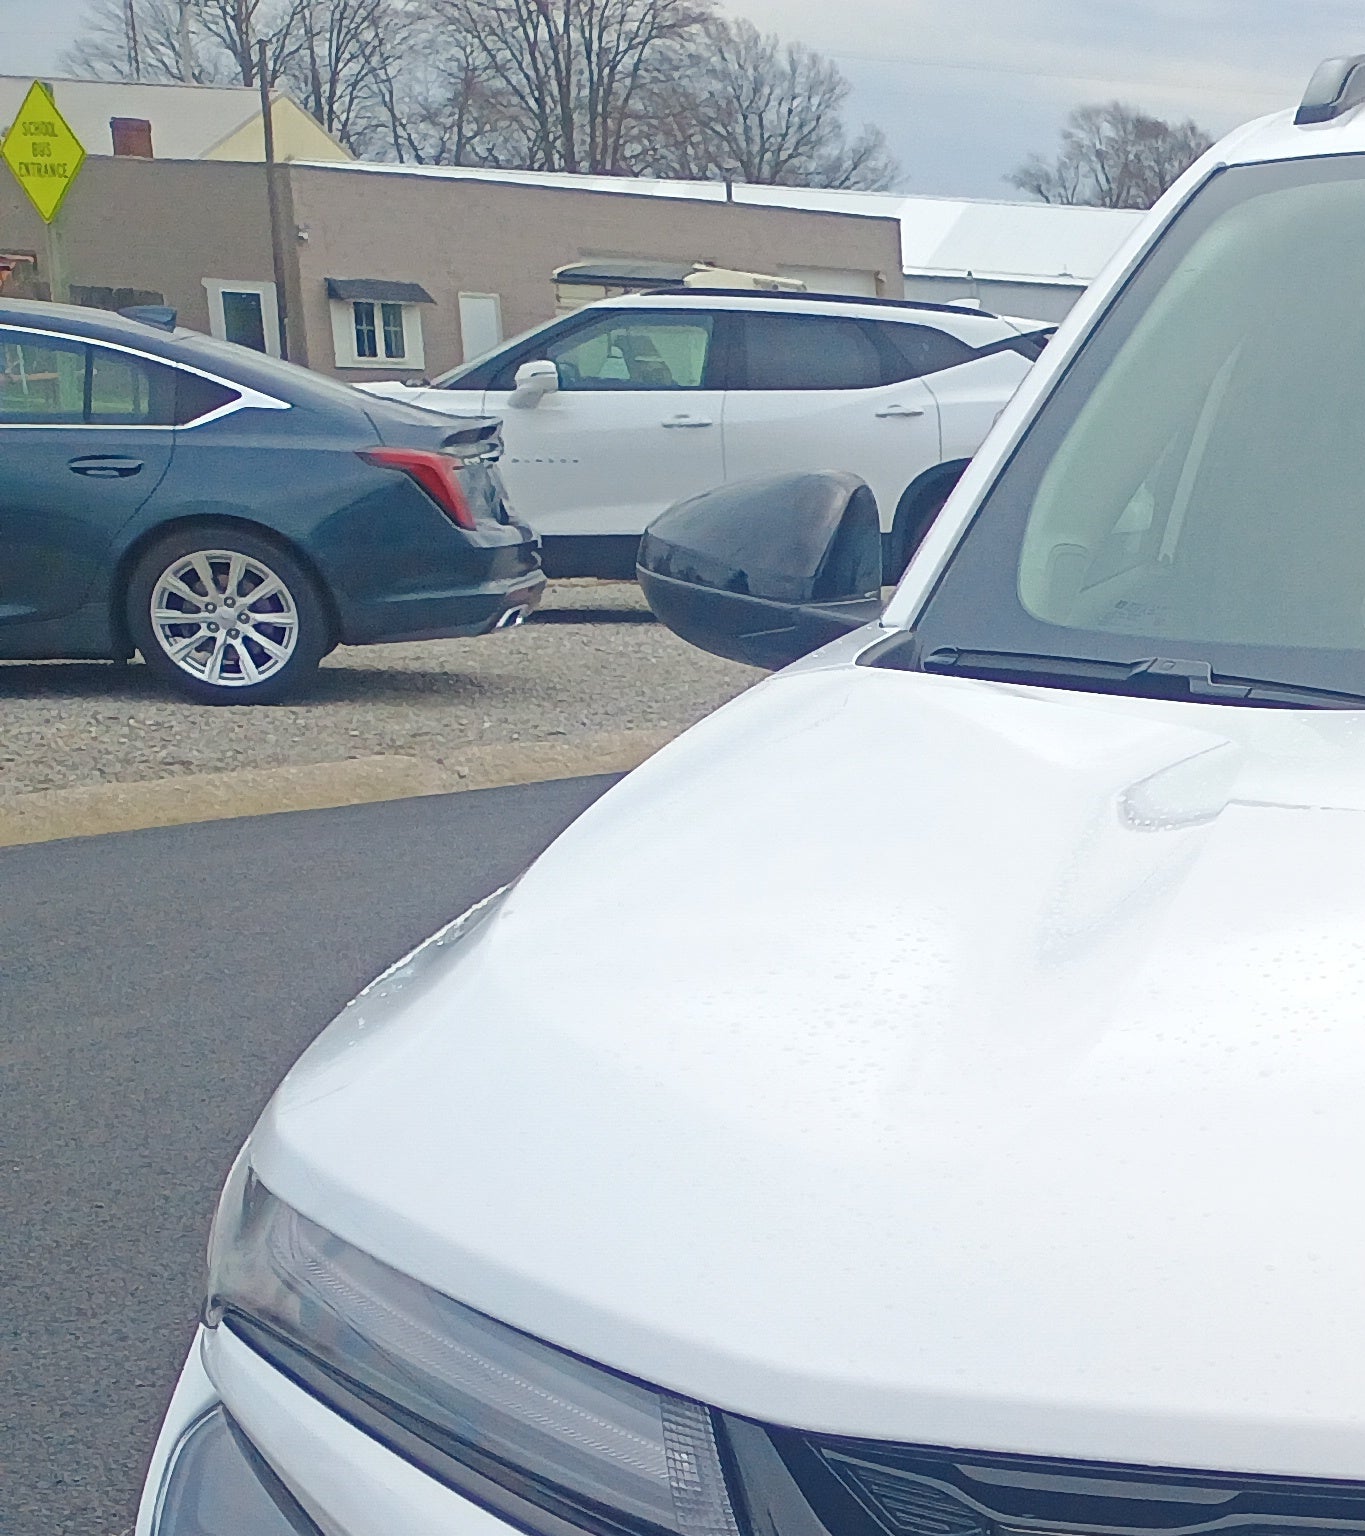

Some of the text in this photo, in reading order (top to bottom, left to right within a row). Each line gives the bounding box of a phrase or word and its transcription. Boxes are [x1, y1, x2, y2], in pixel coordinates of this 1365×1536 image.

[22, 120, 58, 137] SCHOOL
[31, 142, 52, 157] BUS
[19, 161, 69, 178] ENTRANCE
